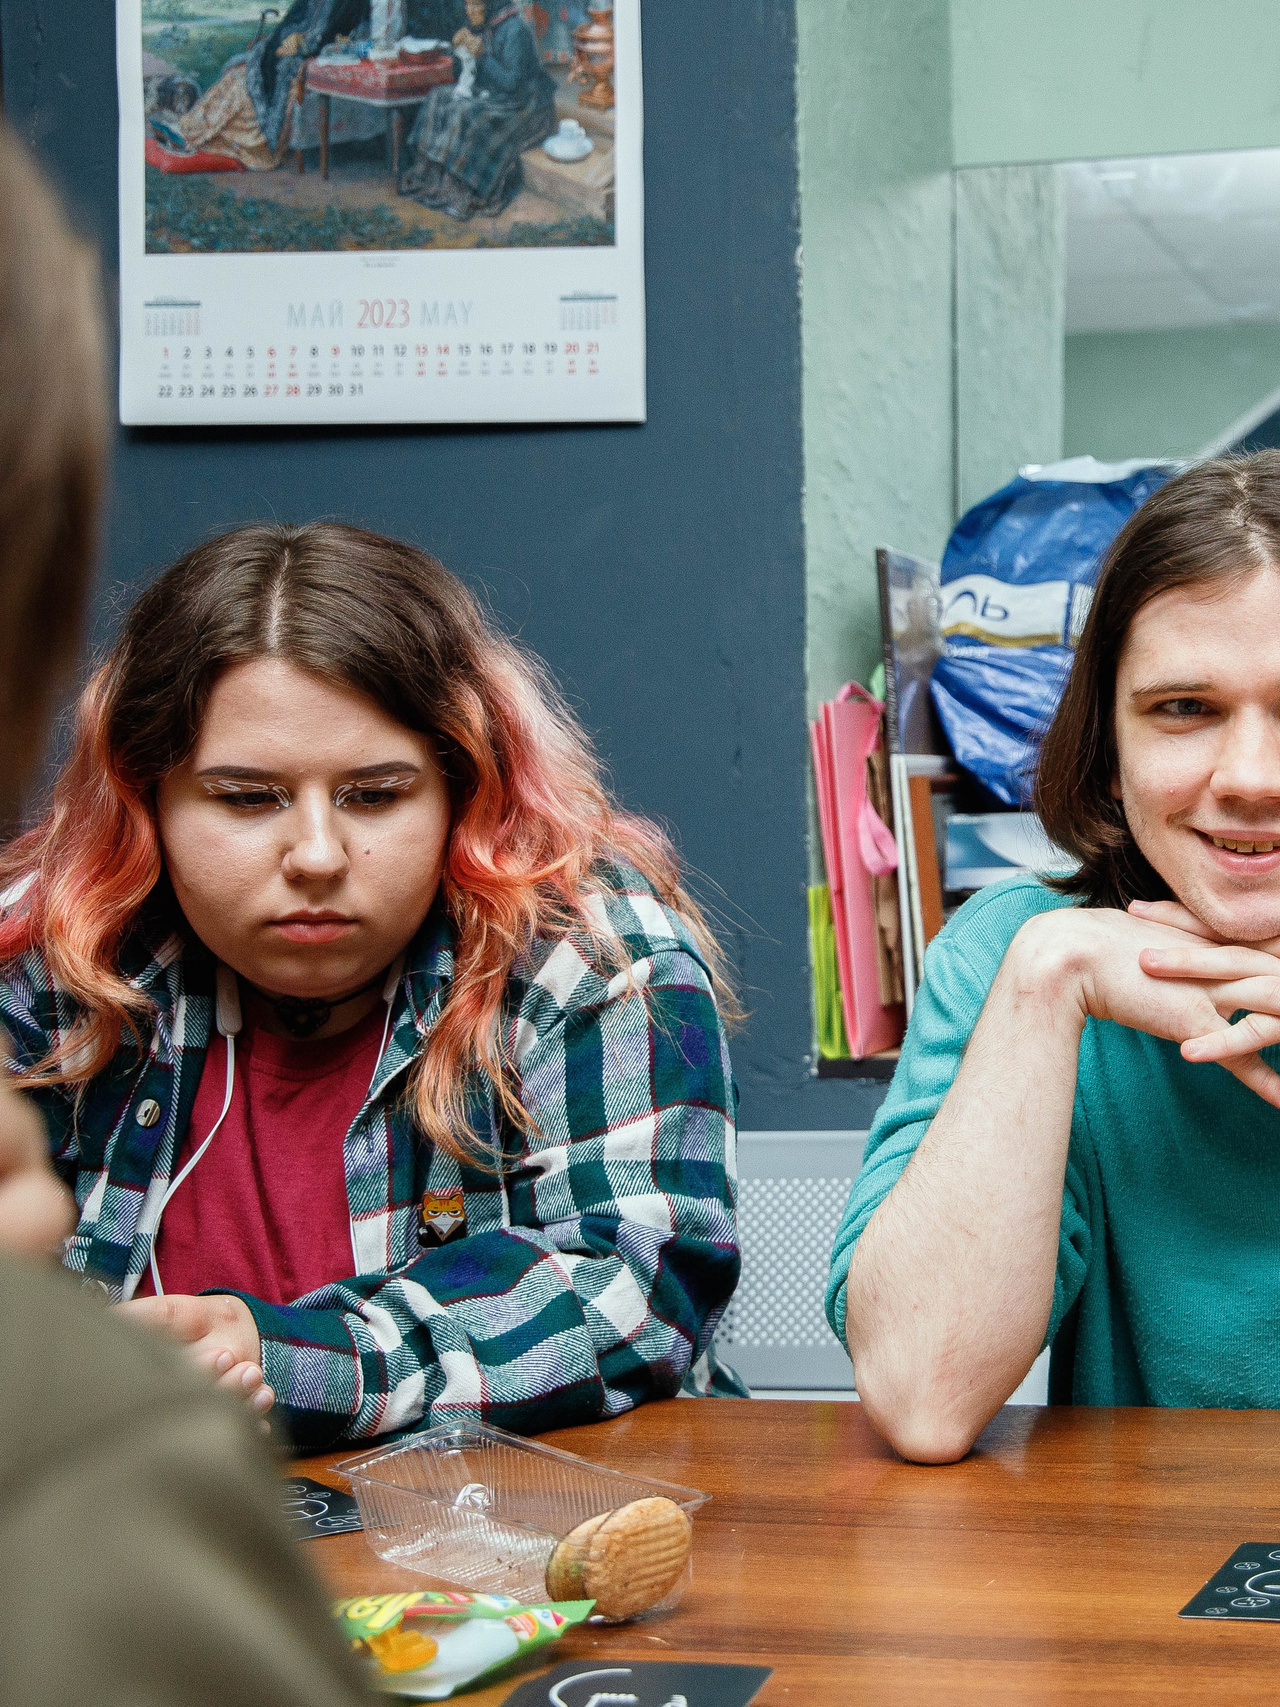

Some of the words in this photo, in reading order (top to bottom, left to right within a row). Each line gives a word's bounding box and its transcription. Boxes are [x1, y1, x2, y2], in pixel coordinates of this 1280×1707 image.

[287, 299, 344, 328] МАЙ
[357, 299, 411, 328] 2023
[420, 299, 474, 327] MAY
[163, 346, 169, 358] 1
[183, 346, 191, 358] 2
[204, 346, 213, 358] 3
[225, 346, 234, 358] 4
[246, 345, 255, 357] 5
[267, 345, 276, 357] 6
[290, 345, 297, 357] 7
[309, 345, 319, 357] 8
[331, 345, 340, 357] 9
[351, 344, 365, 356] 10
[373, 344, 384, 356] 11
[394, 344, 407, 356] 12
[415, 344, 428, 356] 13
[436, 343, 449, 355] 14
[458, 343, 471, 355] 15
[480, 343, 493, 355] 16
[501, 343, 514, 355] 17
[522, 342, 536, 354] 18
[544, 342, 558, 354] 19
[564, 342, 579, 354] 20
[586, 342, 600, 354] 21
[158, 386, 173, 397] 22
[179, 386, 194, 397] 23
[200, 386, 215, 397] 24
[222, 386, 236, 397] 25
[243, 386, 258, 397] 26
[264, 386, 279, 397] 27
[286, 385, 300, 397] 28
[307, 385, 322, 396] 29
[328, 385, 343, 396] 30
[349, 385, 363, 396] 31
